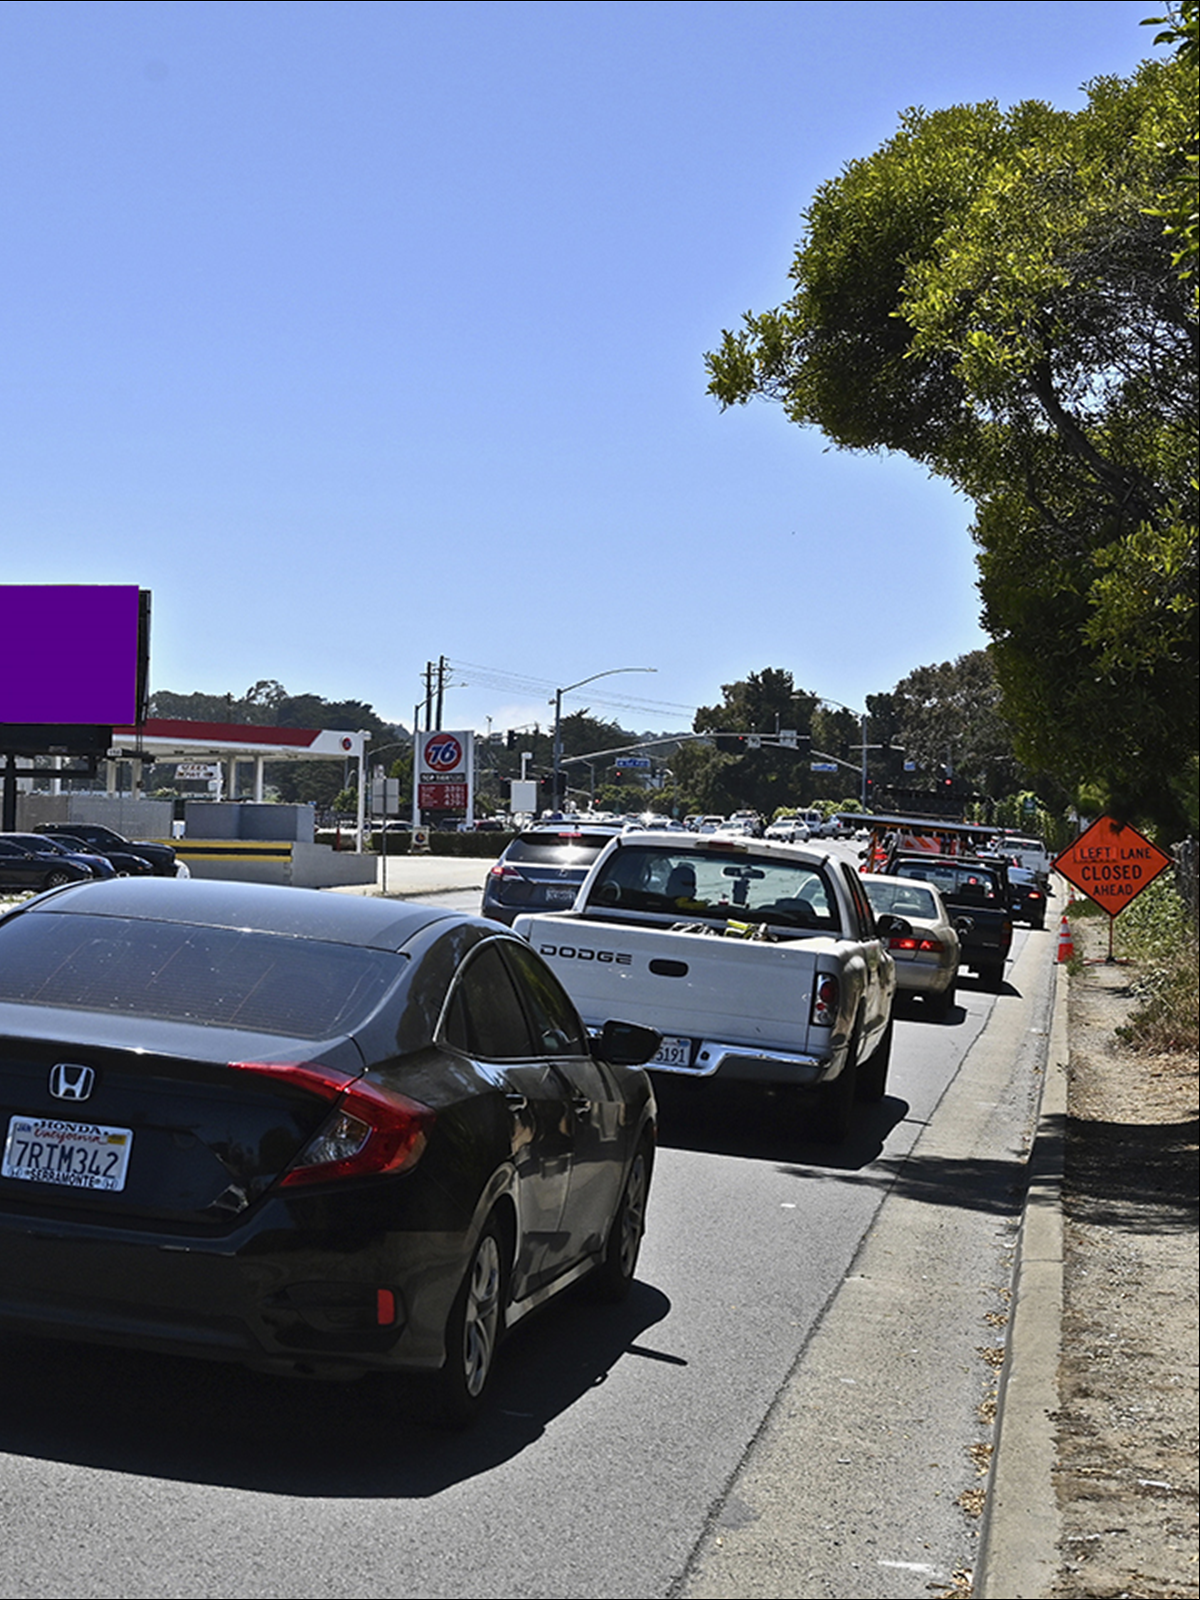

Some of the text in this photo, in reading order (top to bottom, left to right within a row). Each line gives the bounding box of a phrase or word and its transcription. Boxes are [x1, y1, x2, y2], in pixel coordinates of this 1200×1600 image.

[429, 741, 457, 764] 76
[1080, 847, 1152, 860] LEFT LANE
[1081, 865, 1142, 881] CLOSED
[1093, 884, 1134, 896] AHEAD
[540, 944, 632, 965] DODGE
[40, 1121, 102, 1135] HONDA
